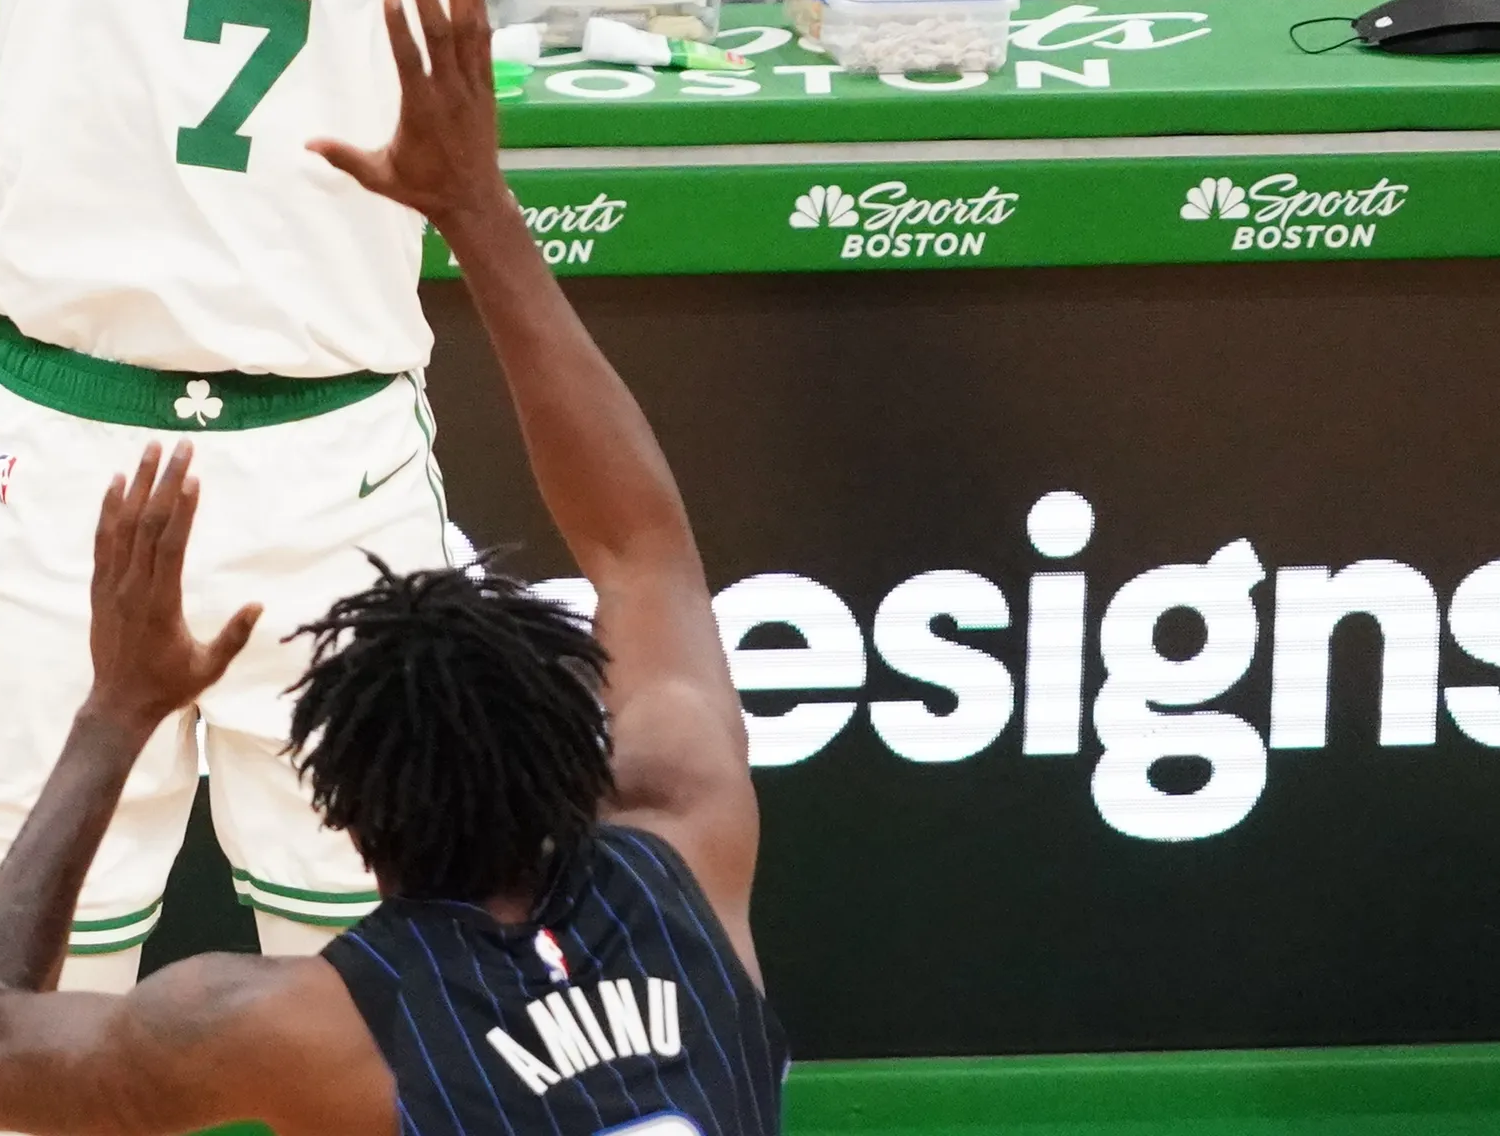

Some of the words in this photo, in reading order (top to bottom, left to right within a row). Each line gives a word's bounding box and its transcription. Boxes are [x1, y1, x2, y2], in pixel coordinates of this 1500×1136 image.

[545, 59, 1111, 98] OSTON
[518, 193, 627, 233] orts
[858, 181, 1019, 238] Sports
[1249, 173, 1409, 231] Sports
[840, 232, 986, 259] BOSTON
[1231, 224, 1376, 250] BOSTON
[711, 490, 1500, 842] esign
[486, 977, 681, 1096] AMINU
